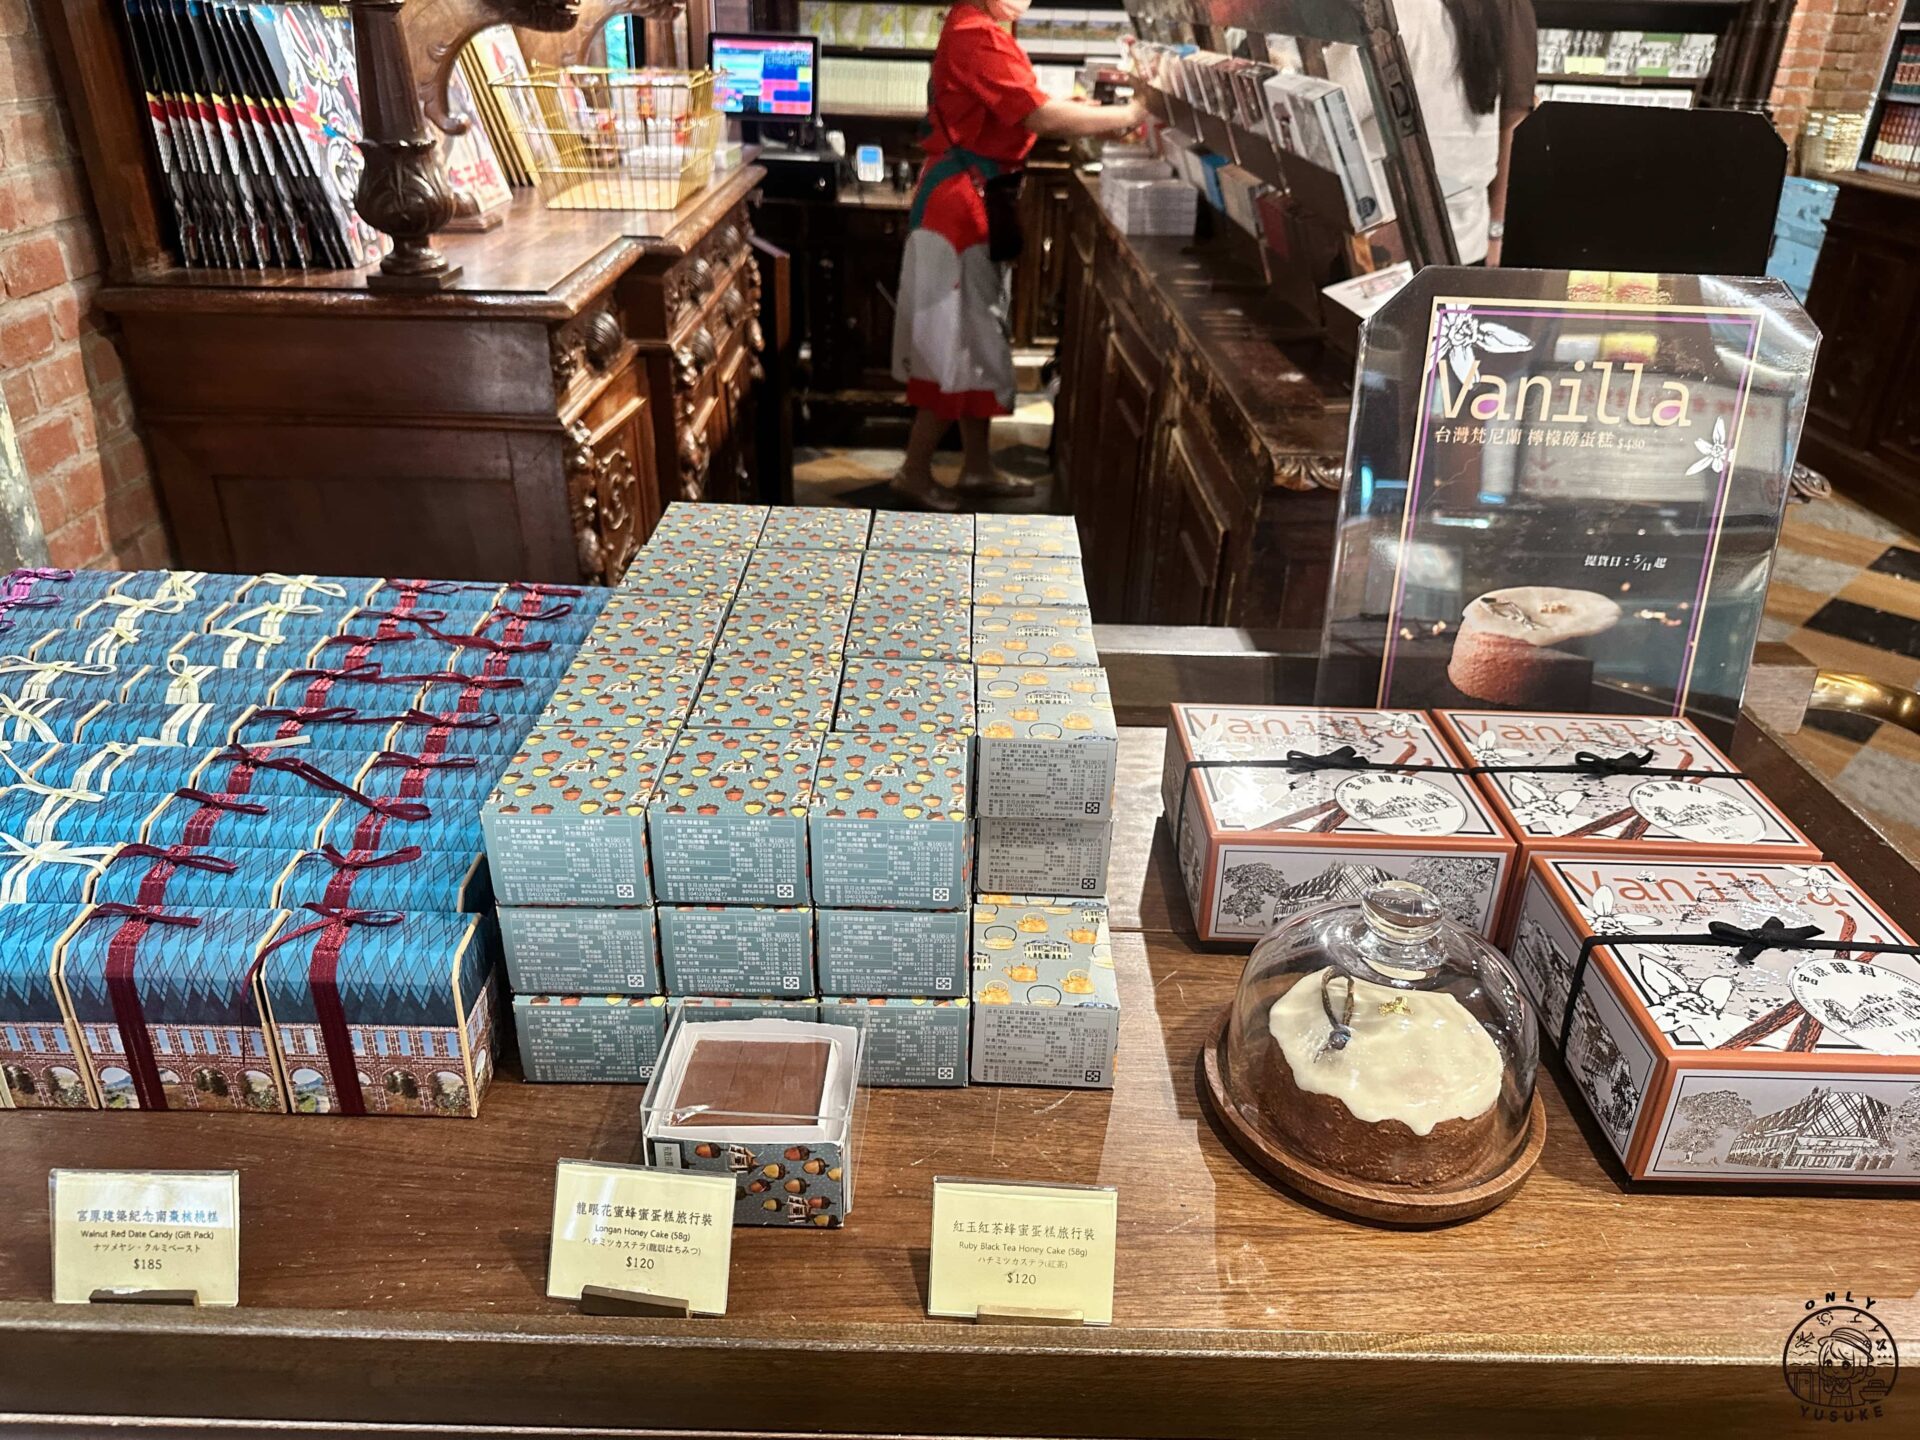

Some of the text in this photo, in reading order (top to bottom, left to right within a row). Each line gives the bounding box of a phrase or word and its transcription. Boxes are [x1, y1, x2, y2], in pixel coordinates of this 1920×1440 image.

[1438, 359, 1691, 427] Vanilla
[1435, 426, 1645, 451] 台灣梵尼蘭 檸檬磅蛋糕 $480
[1189, 713, 1419, 739] Vanilla
[1457, 719, 1692, 747] Vanilla
[1563, 870, 1850, 906] Vanilla
[576, 1201, 713, 1227] 龍眼花蜜蜂蜜蛋糕旅行裝
[81, 1230, 214, 1241] Walnut Red Date Candy (Gift Pack)
[595, 1224, 691, 1242] Longan Honey Cake (58g)
[952, 1220, 1095, 1241] 紅玉紅茶蜂蜜蛋糕旅行裝
[959, 1241, 1088, 1258] Ruby Black Tea Honey Cake (58g)
[133, 1258, 162, 1270] $185
[625, 1256, 655, 1270] $120
[1006, 1272, 1037, 1285] $120
